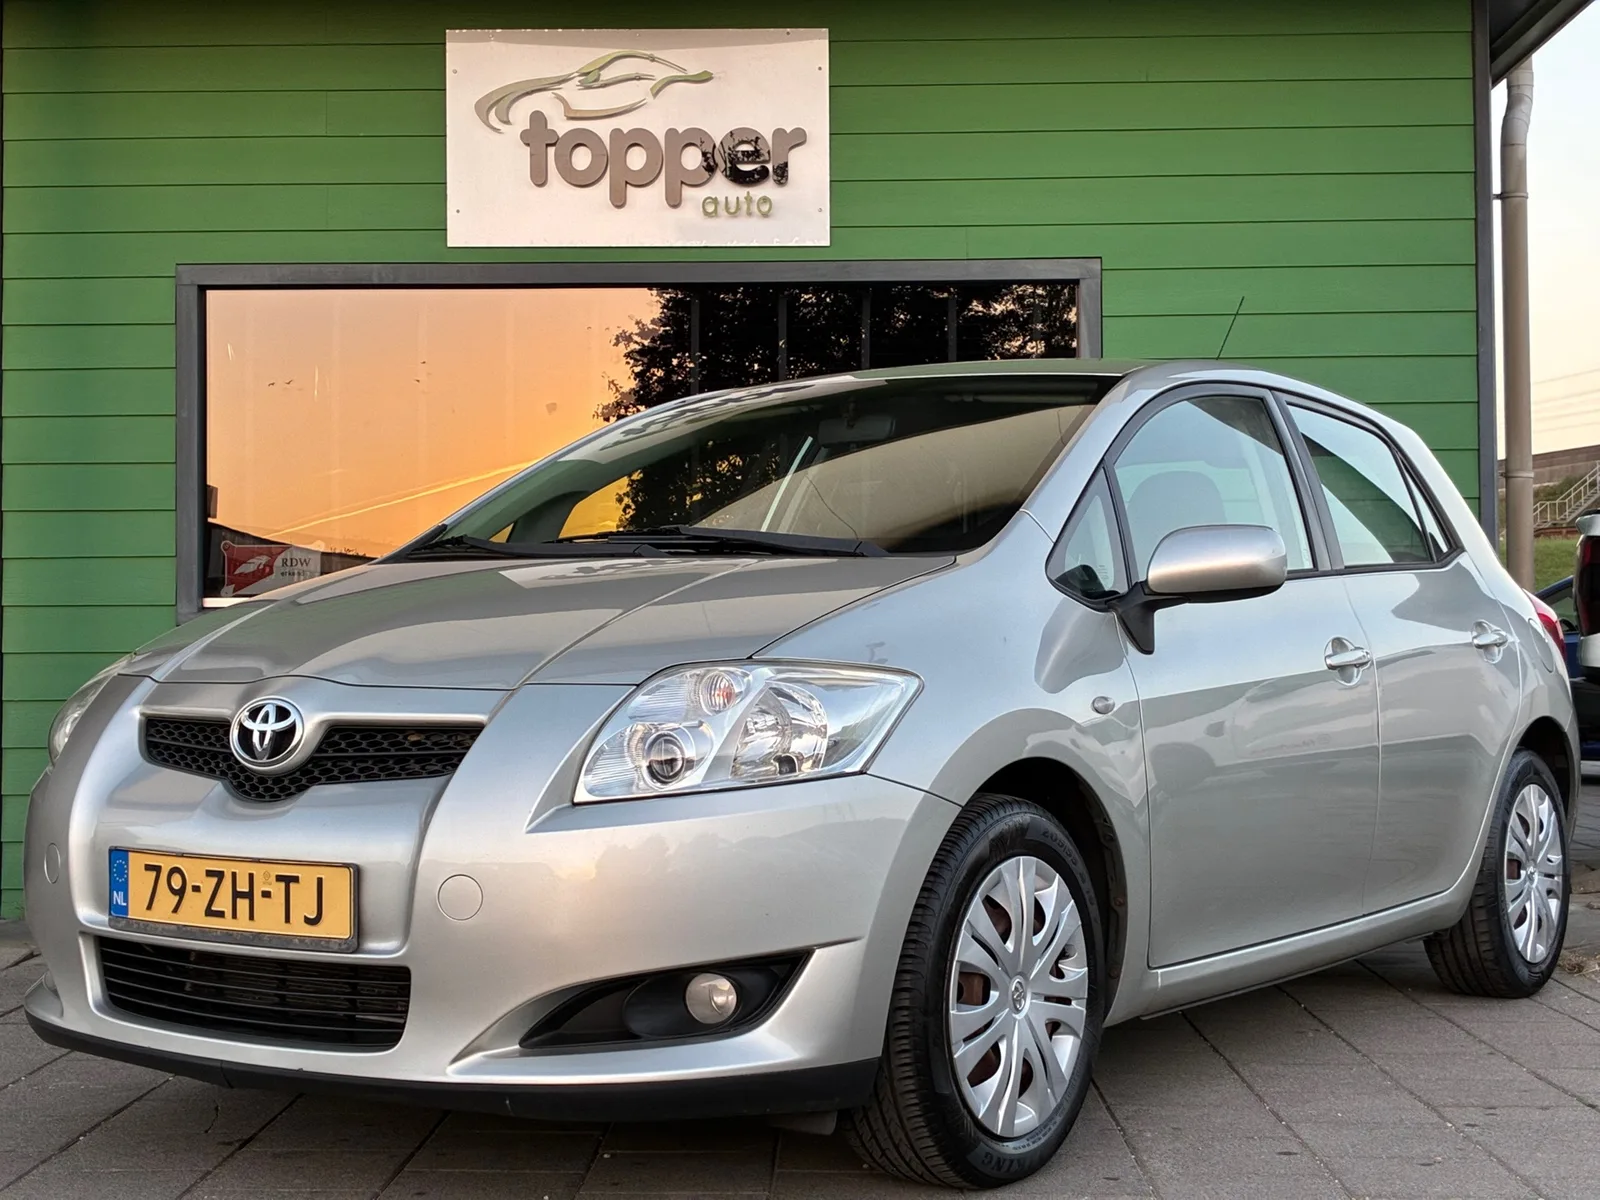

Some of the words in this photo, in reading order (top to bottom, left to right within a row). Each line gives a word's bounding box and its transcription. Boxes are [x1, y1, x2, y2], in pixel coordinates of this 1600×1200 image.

[519, 109, 808, 209] topper
[701, 190, 774, 218] auto
[281, 557, 312, 567] RDW
[112, 890, 127, 906] NL
[144, 863, 324, 926] 79-ZH-TJ
